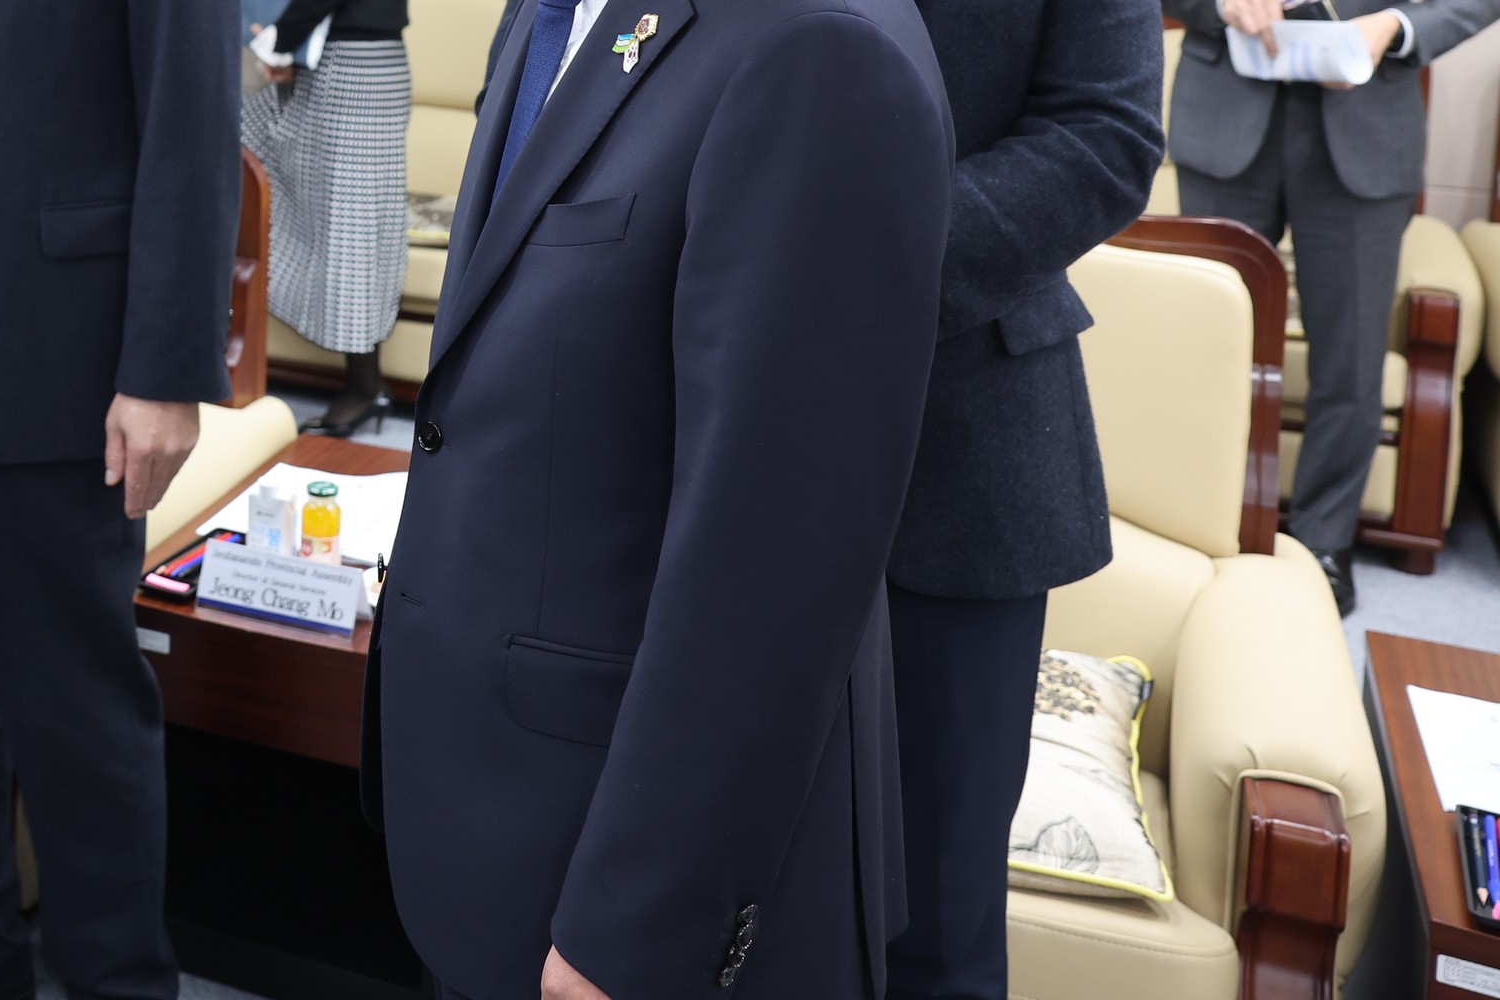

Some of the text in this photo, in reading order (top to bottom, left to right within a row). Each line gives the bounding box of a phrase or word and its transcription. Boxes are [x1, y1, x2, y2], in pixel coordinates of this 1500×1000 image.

[209, 576, 344, 621] Jeong Chang Mo
